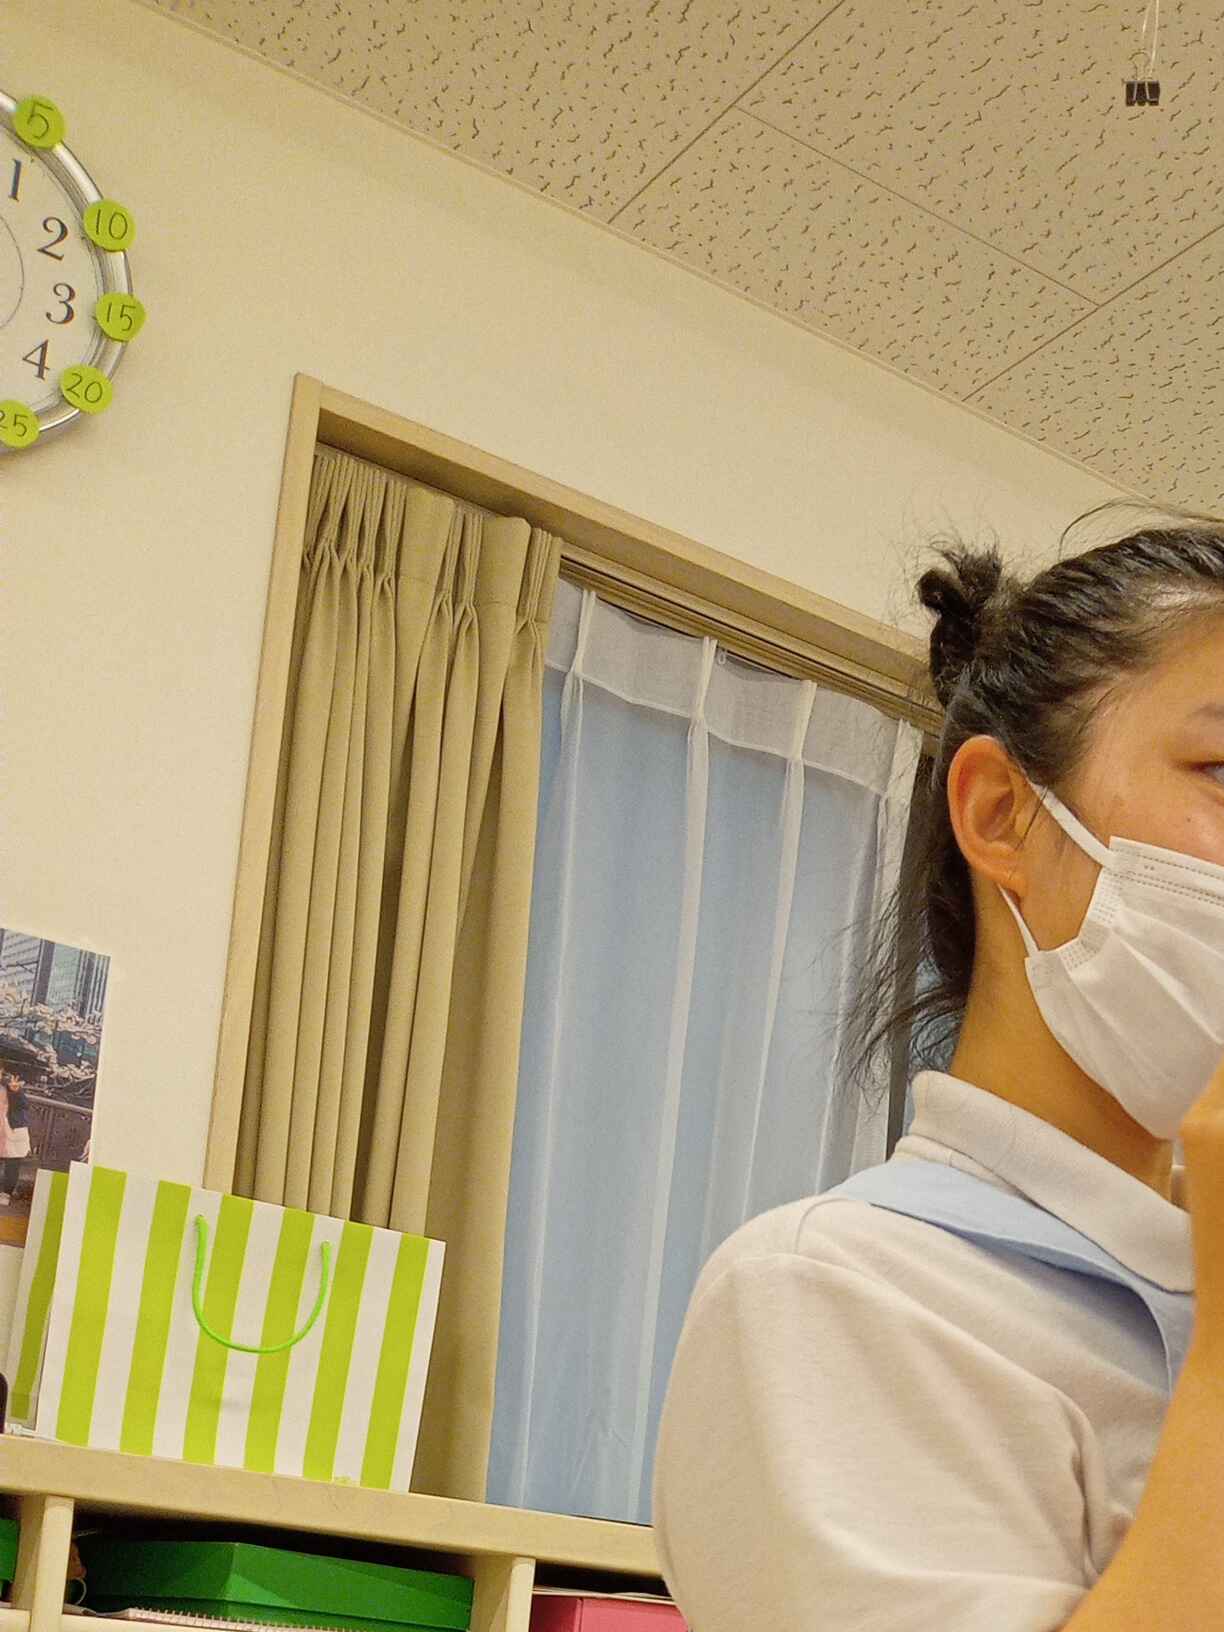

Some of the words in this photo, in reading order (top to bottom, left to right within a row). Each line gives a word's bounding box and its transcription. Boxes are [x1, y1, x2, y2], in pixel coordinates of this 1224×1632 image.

[27, 101, 55, 139] 5
[8, 158, 22, 202] 1
[37, 217, 68, 261] 2
[95, 208, 128, 241] 10
[45, 282, 76, 325] 3
[106, 302, 137, 332] 15
[22, 339, 50, 381] 4
[66, 372, 104, 404] 20
